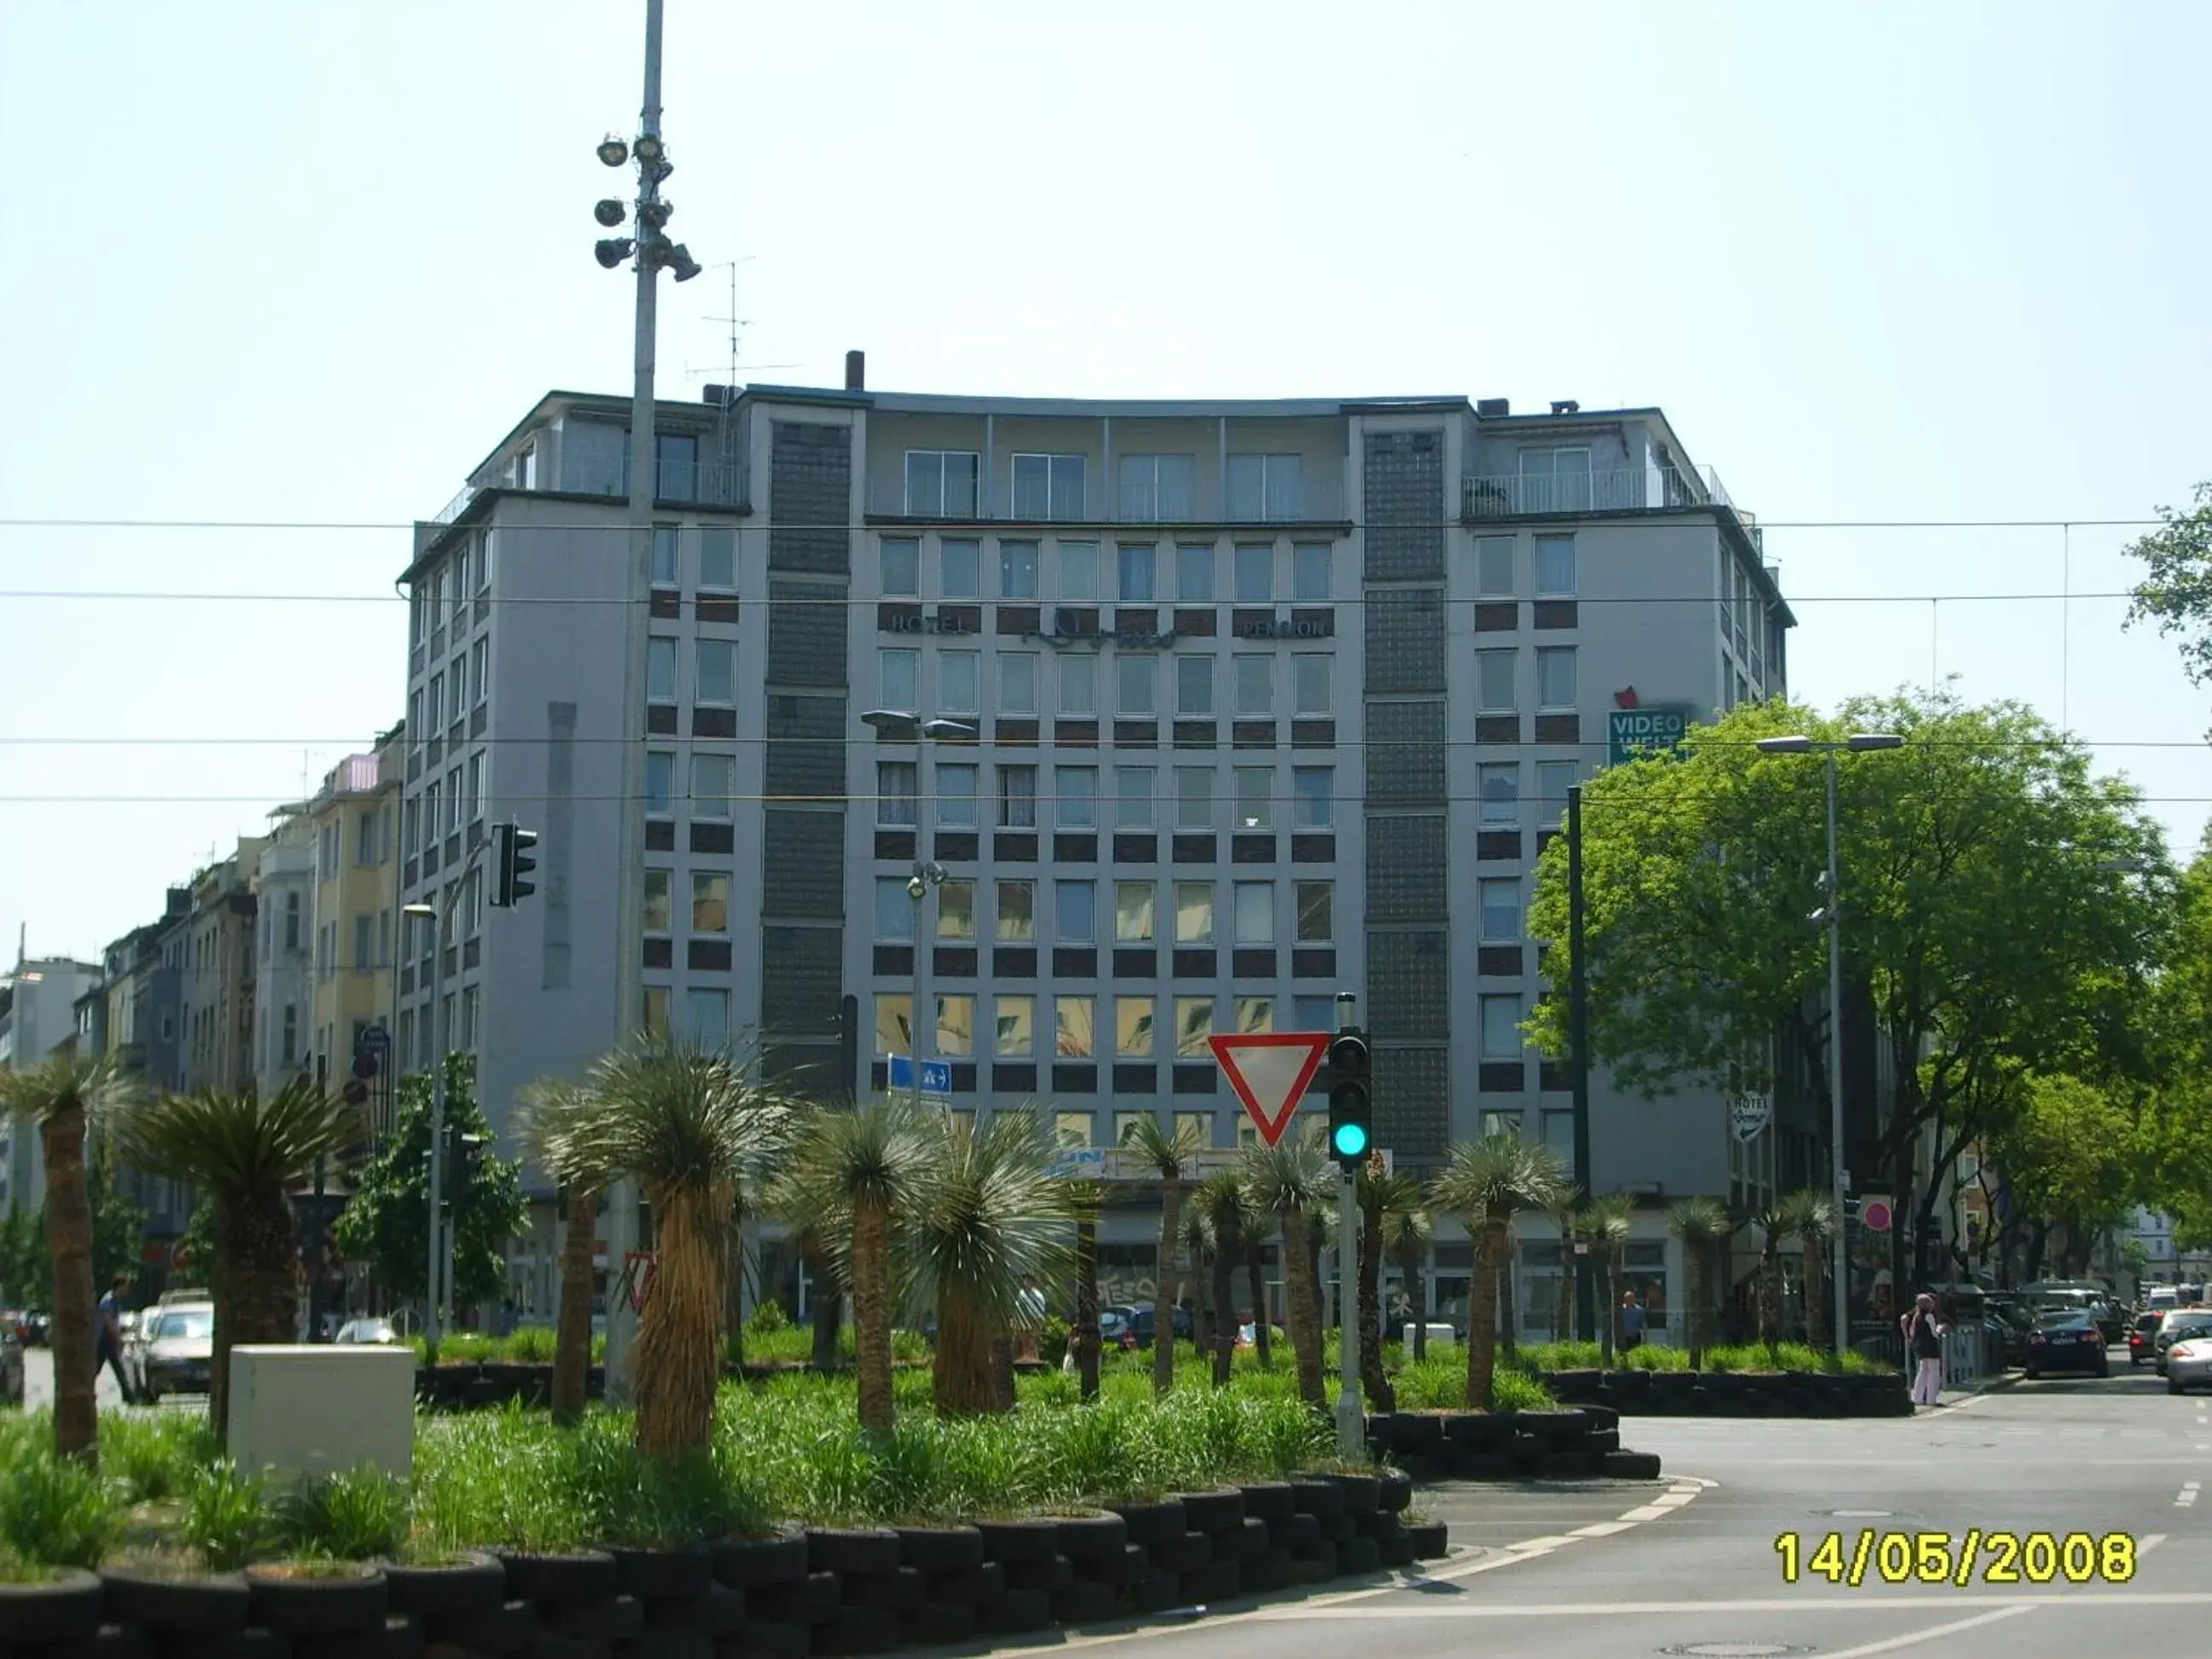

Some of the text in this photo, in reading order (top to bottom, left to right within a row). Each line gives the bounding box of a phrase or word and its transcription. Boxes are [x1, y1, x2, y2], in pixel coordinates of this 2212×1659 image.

[892, 614, 967, 633] HOTEL
[1243, 619, 1326, 637] PENSION
[1613, 715, 1681, 735] VIDEO
[1735, 1098, 1767, 1109] HOTEL
